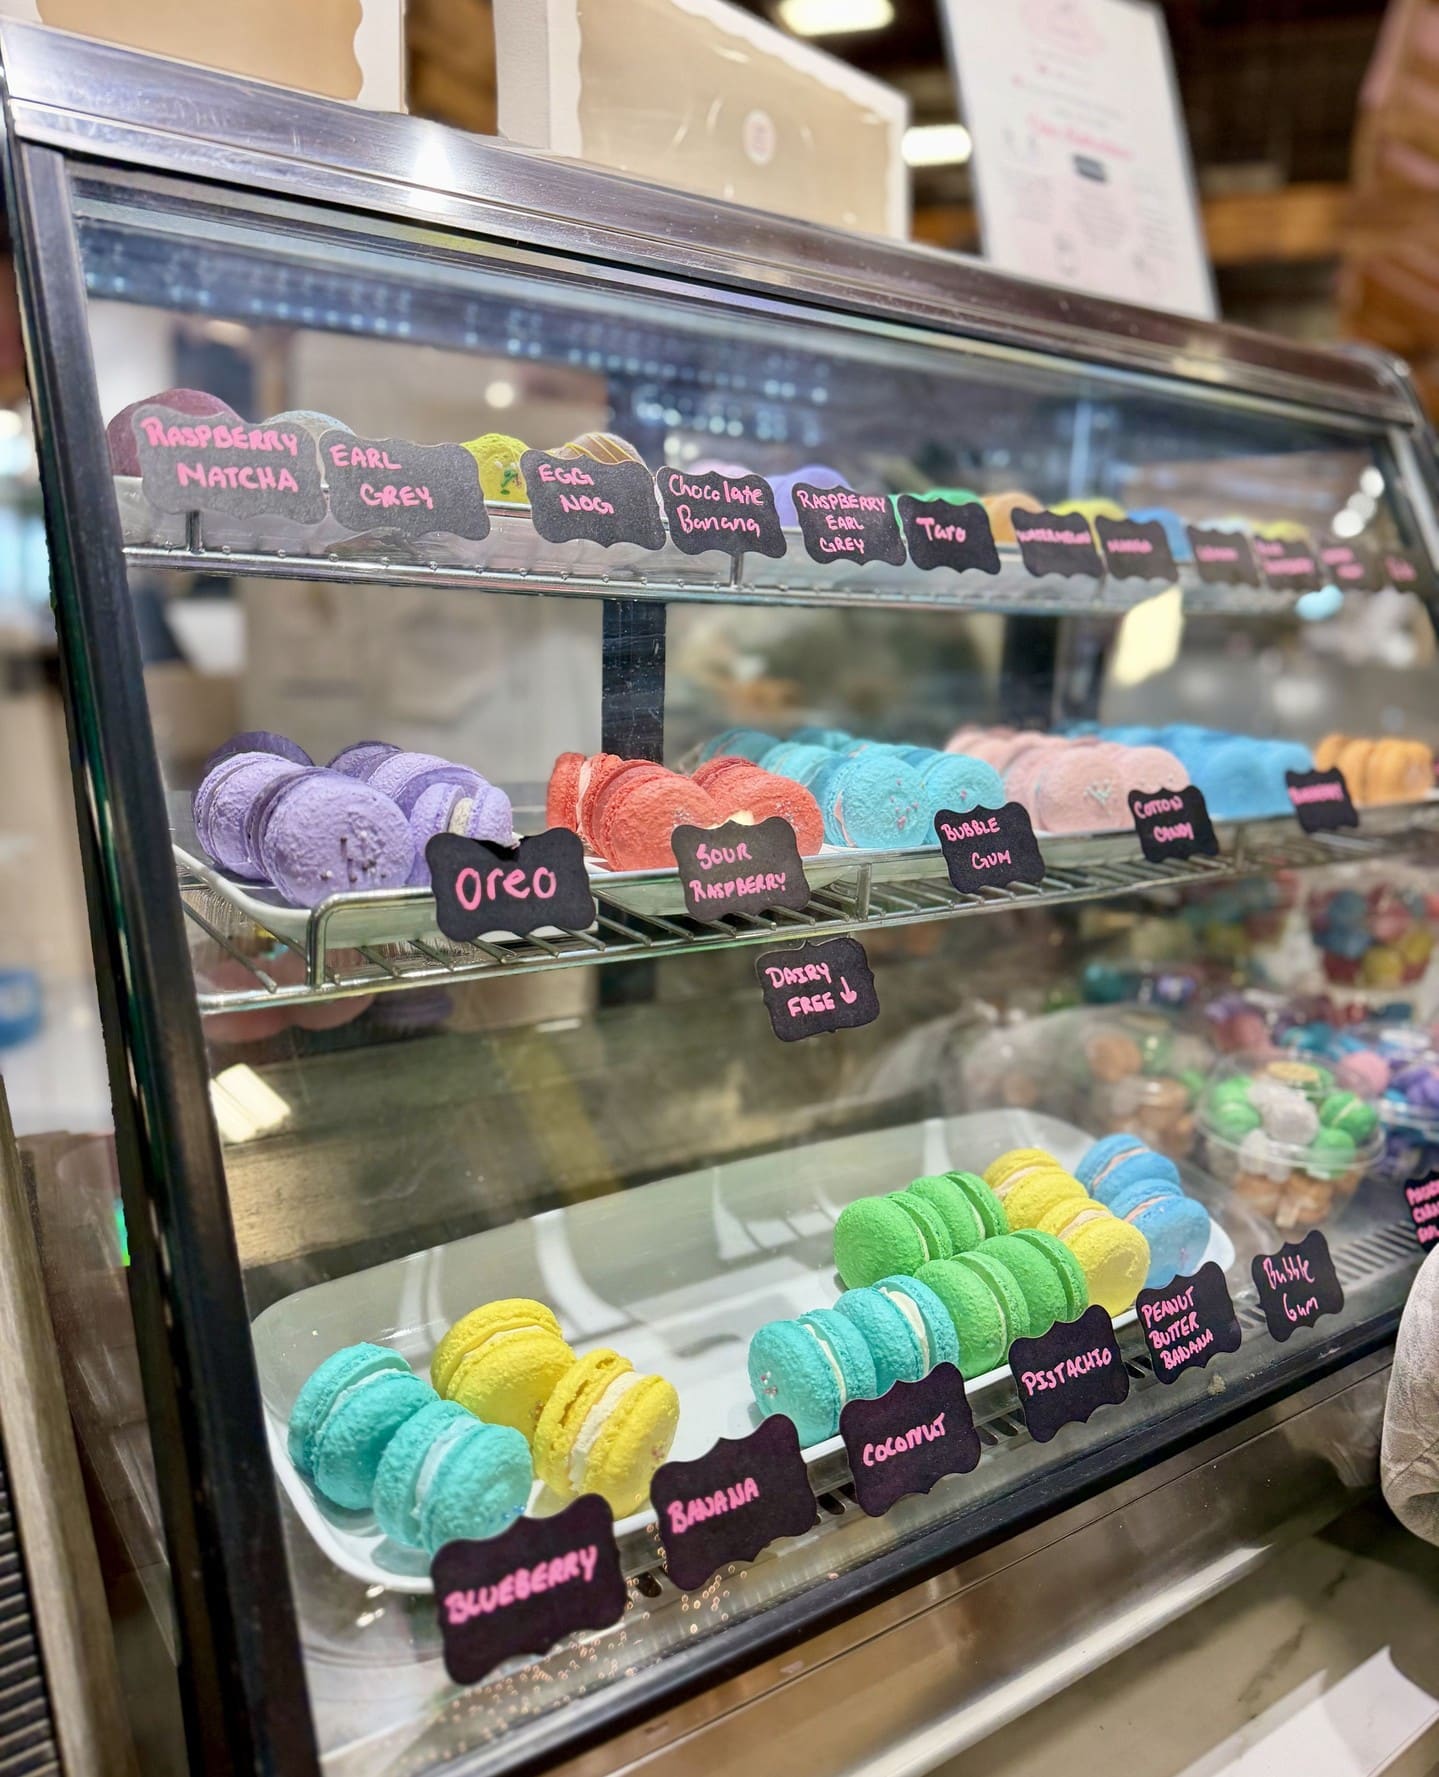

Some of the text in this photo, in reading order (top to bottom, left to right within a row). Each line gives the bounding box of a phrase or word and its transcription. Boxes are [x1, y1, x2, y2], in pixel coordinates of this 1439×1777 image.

[140, 416, 299, 456] RASPBERRY
[329, 444, 402, 471] EARL
[176, 462, 299, 493] MATCHA
[537, 463, 595, 486] EGG
[359, 483, 434, 511] GREY
[559, 495, 615, 515] NOG
[668, 474, 764, 506] Chocolate
[796, 490, 886, 513] RASPBERRY
[675, 504, 761, 538] Banana
[825, 514, 865, 531] EARL
[915, 517, 967, 543] Taro
[819, 536, 865, 554] GREY
[1133, 795, 1184, 819] COTTON
[940, 816, 1001, 843] BUBBLE
[695, 842, 752, 870] SOUR
[970, 849, 1012, 870] GUM
[455, 866, 558, 912] Oreo
[688, 872, 787, 903] RASPBERRY
[765, 962, 832, 989] DAIRY
[787, 991, 836, 1017] FREE
[1262, 1253, 1316, 1291] Bubble
[1140, 1285, 1194, 1329] PEANUT
[1282, 1293, 1319, 1323] Gum
[1149, 1311, 1200, 1350] BUTTER
[1159, 1328, 1214, 1371] BANANA
[1020, 1347, 1113, 1396] PISTACHIO
[861, 1412, 946, 1468] COCONUT
[666, 1476, 760, 1535] BANANA
[444, 1544, 598, 1625] BLUEBERRY
